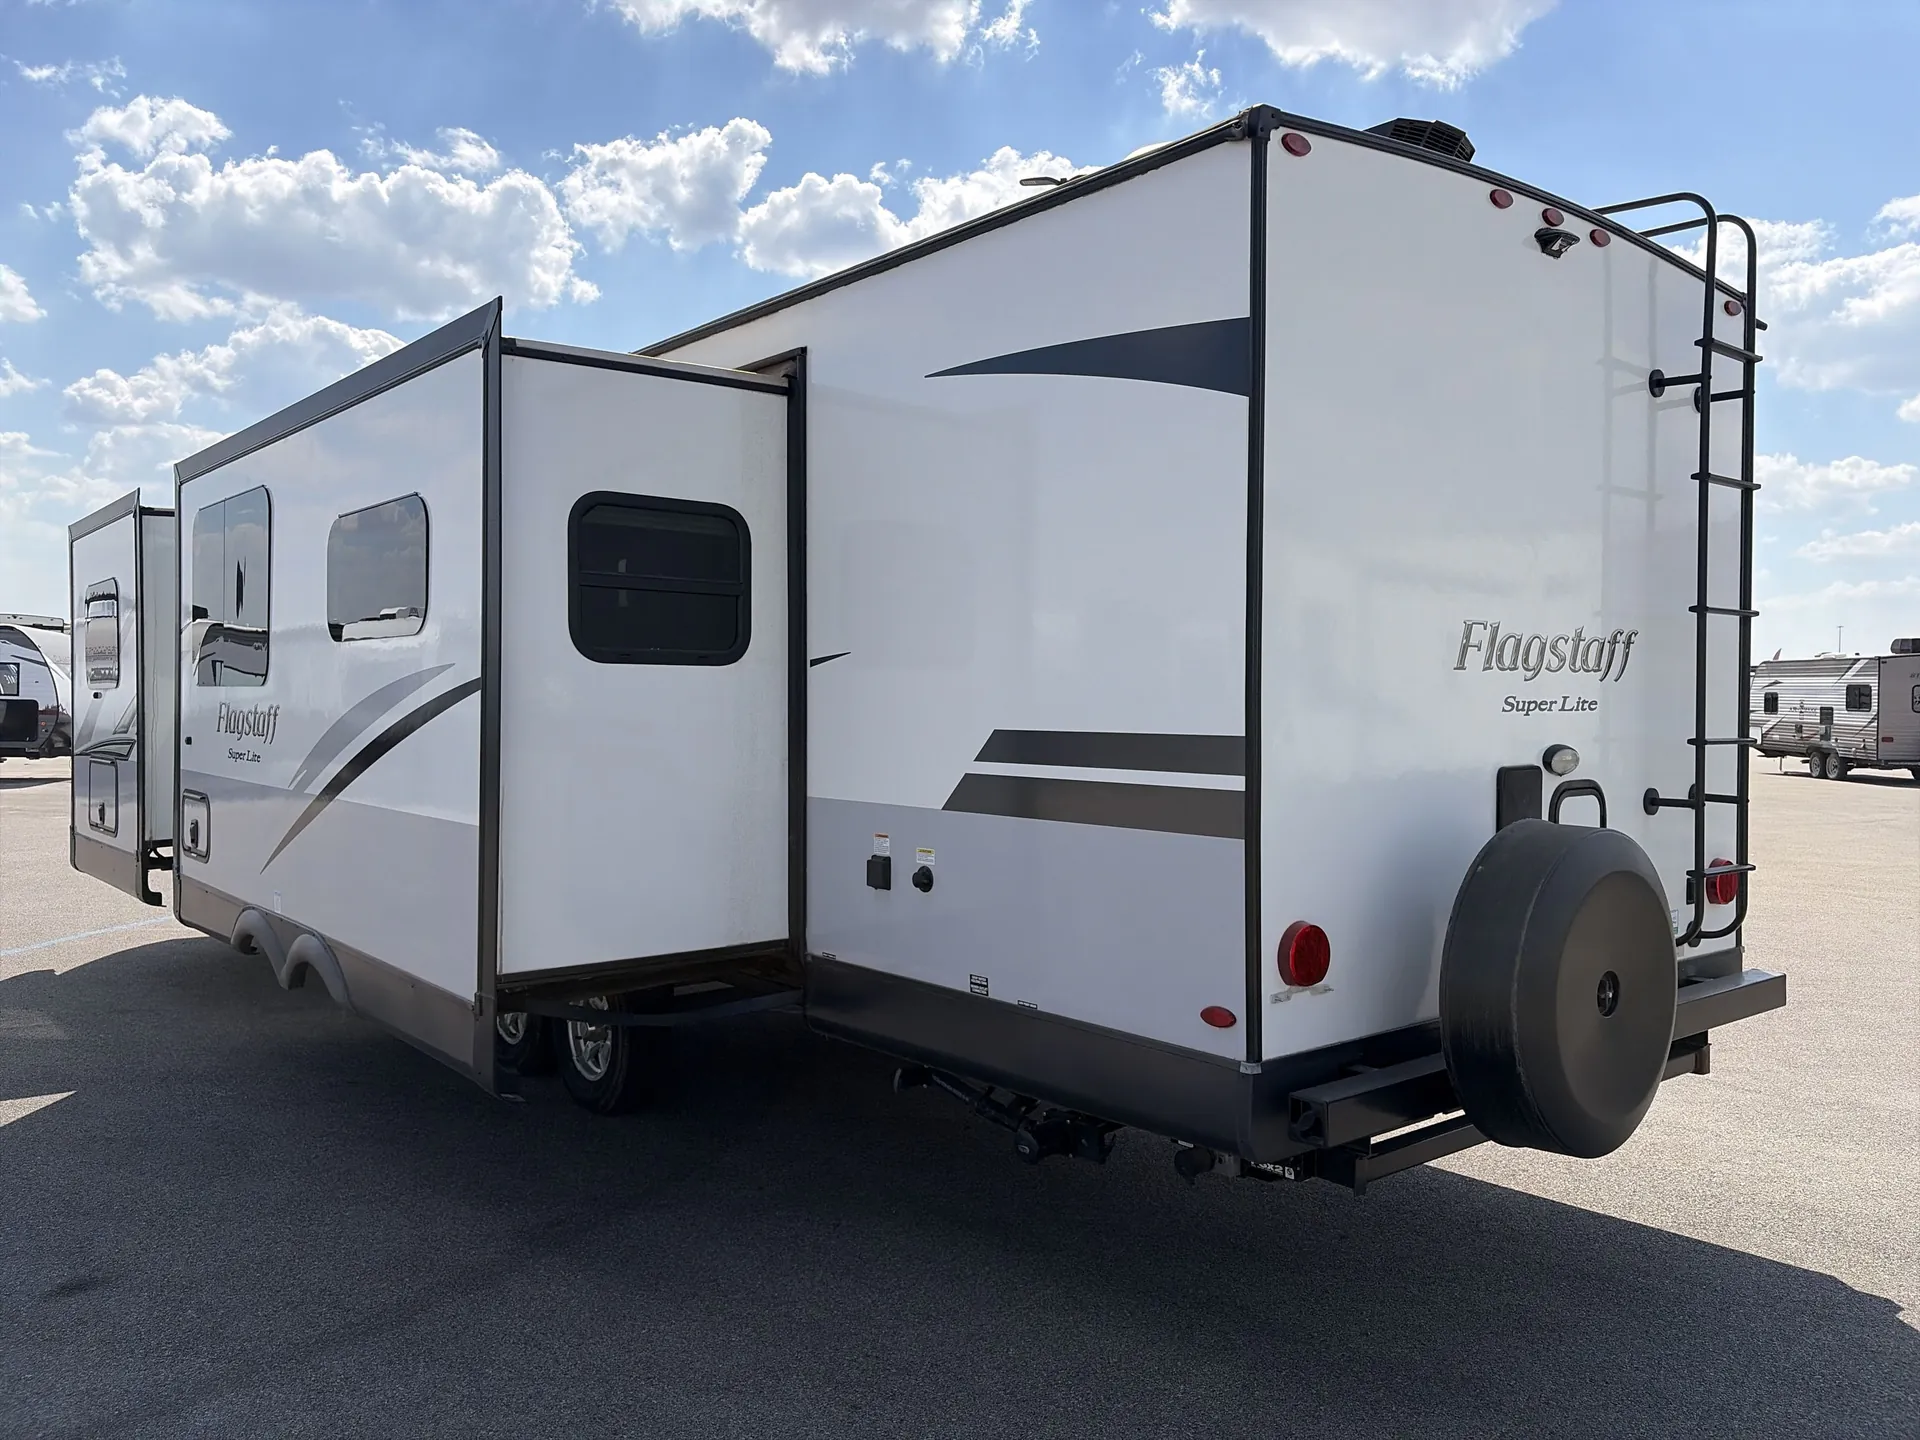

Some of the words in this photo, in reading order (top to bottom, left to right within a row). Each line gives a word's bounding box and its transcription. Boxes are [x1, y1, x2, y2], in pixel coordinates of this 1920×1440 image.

[1453, 619, 1639, 682] Flagstaff
[1502, 695, 1557, 716] Super
[1558, 696, 1598, 712] Lite
[216, 701, 280, 745] Flagstaff
[228, 748, 246, 762] Super
[246, 750, 261, 763] Lite
